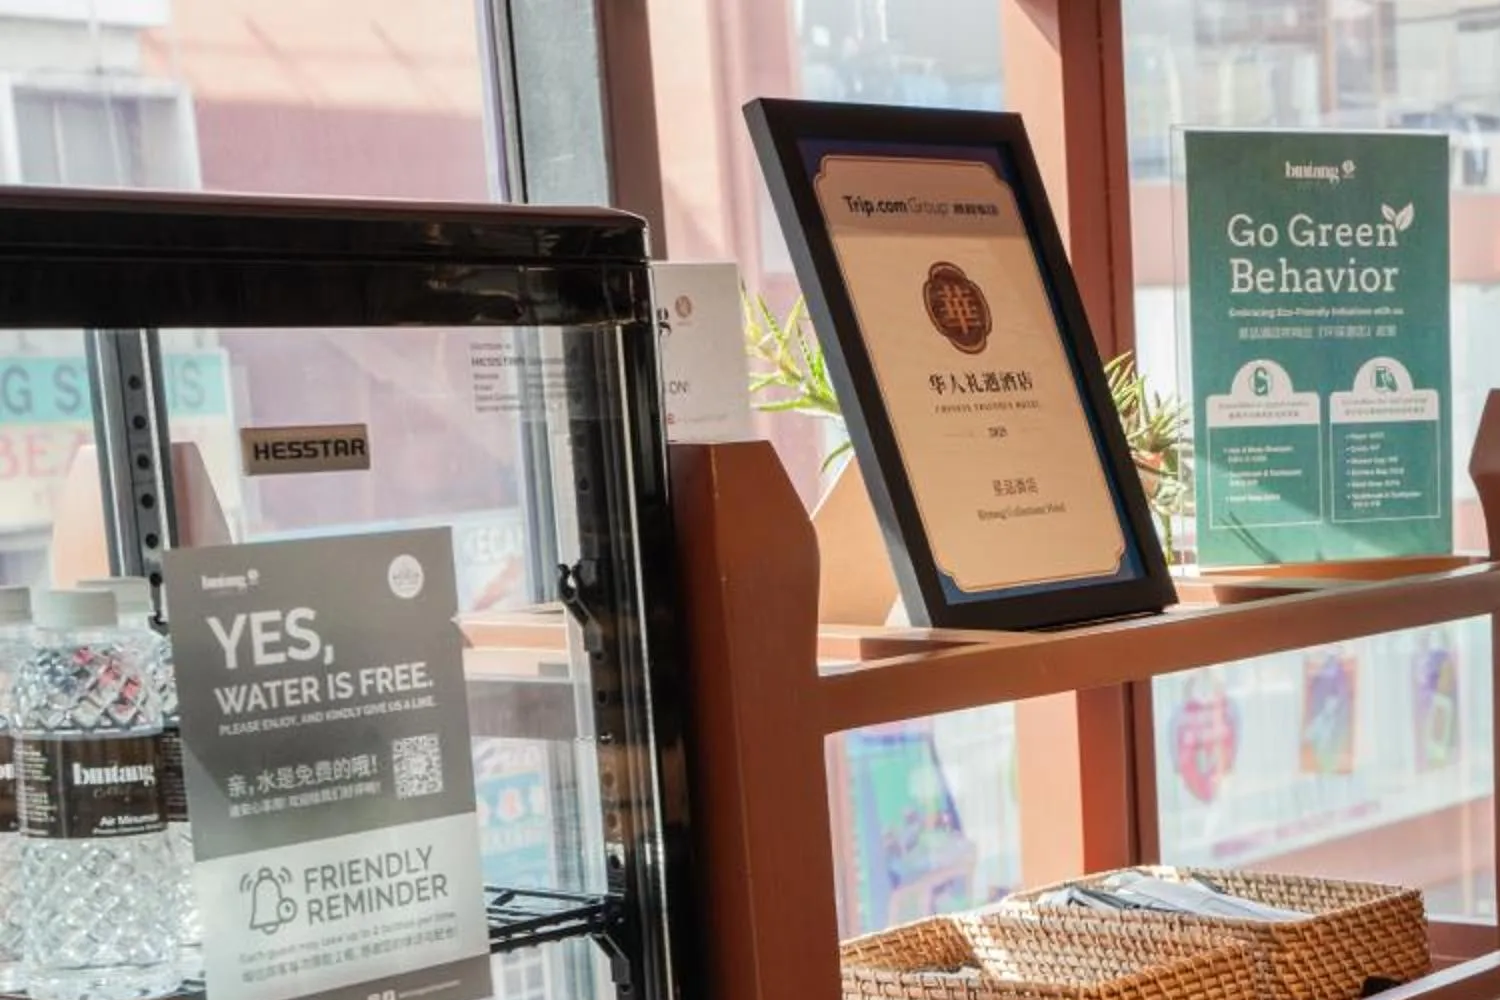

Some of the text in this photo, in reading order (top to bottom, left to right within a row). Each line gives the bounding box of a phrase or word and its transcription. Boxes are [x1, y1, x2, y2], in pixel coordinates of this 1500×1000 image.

[1227, 213, 1398, 247] Go Green
[1229, 257, 1399, 294] Behavior
[253, 438, 366, 462] HESSTAR
[206, 606, 335, 671] YES,
[214, 661, 435, 716] WATER IS FREE.
[218, 719, 262, 737] PLEASE
[302, 712, 324, 725] AND
[326, 707, 362, 722] KINDLY
[363, 702, 389, 716] GIVE
[389, 700, 403, 713] US
[404, 699, 412, 710] A
[303, 845, 433, 894] FRIENDLY
[306, 873, 449, 925] REMINDER
